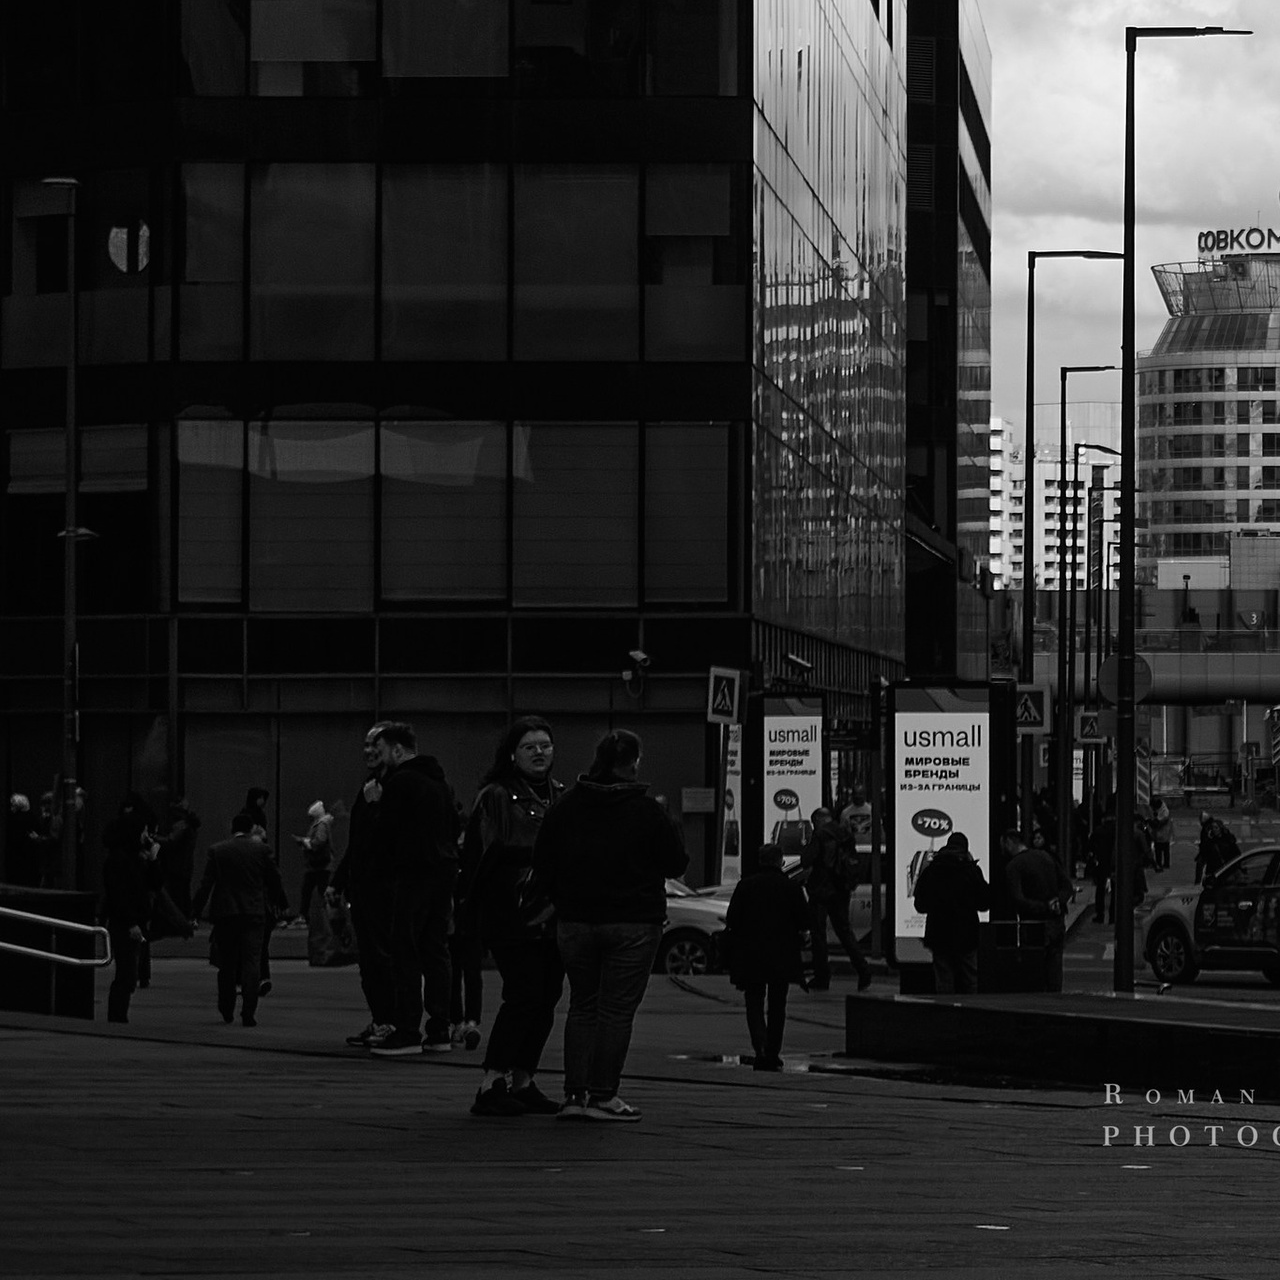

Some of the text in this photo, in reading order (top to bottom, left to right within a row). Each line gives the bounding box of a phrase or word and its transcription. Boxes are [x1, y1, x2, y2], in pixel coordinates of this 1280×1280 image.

[768, 725, 817, 743] usmall
[903, 724, 982, 748] usmall
[904, 757, 971, 767] МИРОВЫЕ
[904, 770, 960, 781] БРЕНДЫ
[900, 783, 981, 793] ИЗ-ЗА ГРАНИЦЫ
